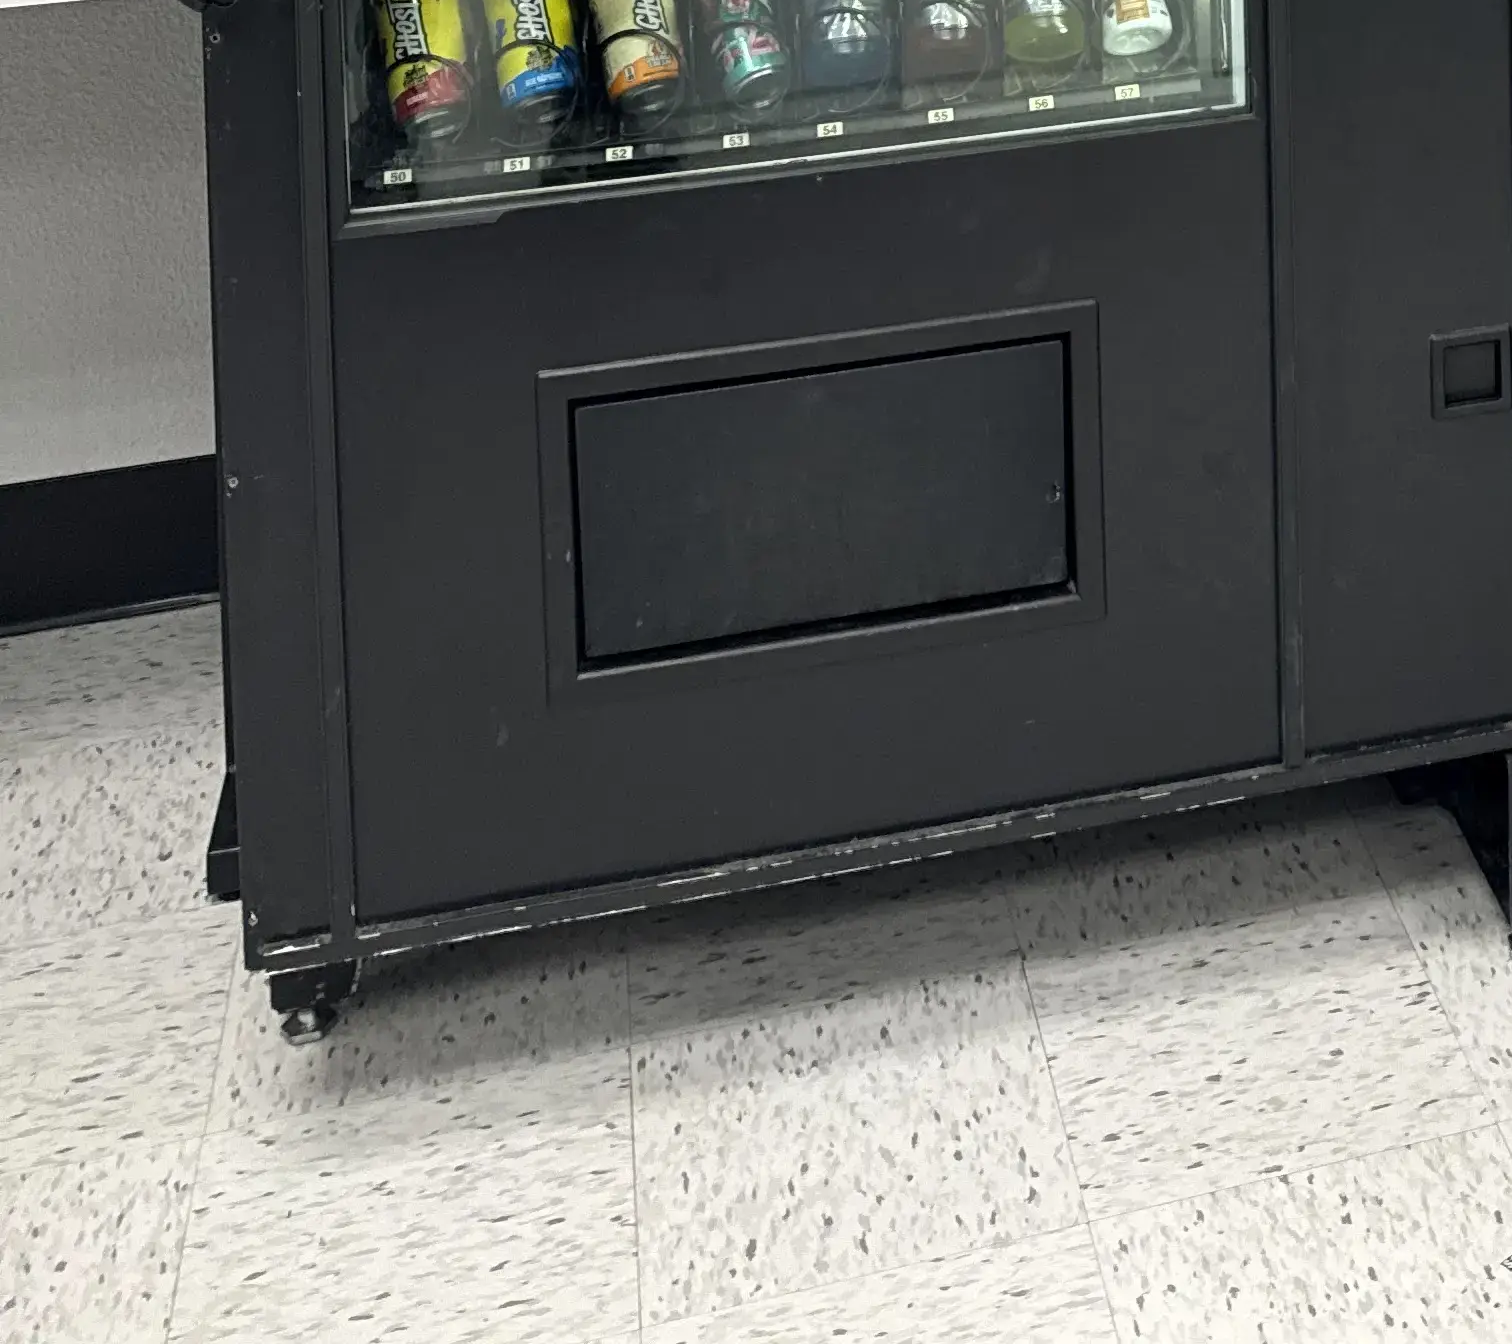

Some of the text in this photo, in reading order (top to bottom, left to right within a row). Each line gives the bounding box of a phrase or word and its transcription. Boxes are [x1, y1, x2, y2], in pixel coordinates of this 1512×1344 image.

[1120, 87, 1134, 98] 57
[1034, 98, 1049, 108] 56
[934, 112, 948, 122] 55
[823, 124, 837, 134] 54
[729, 136, 744, 145] 53
[611, 149, 627, 159] 52
[509, 160, 523, 169] 51
[390, 172, 406, 182] 50
